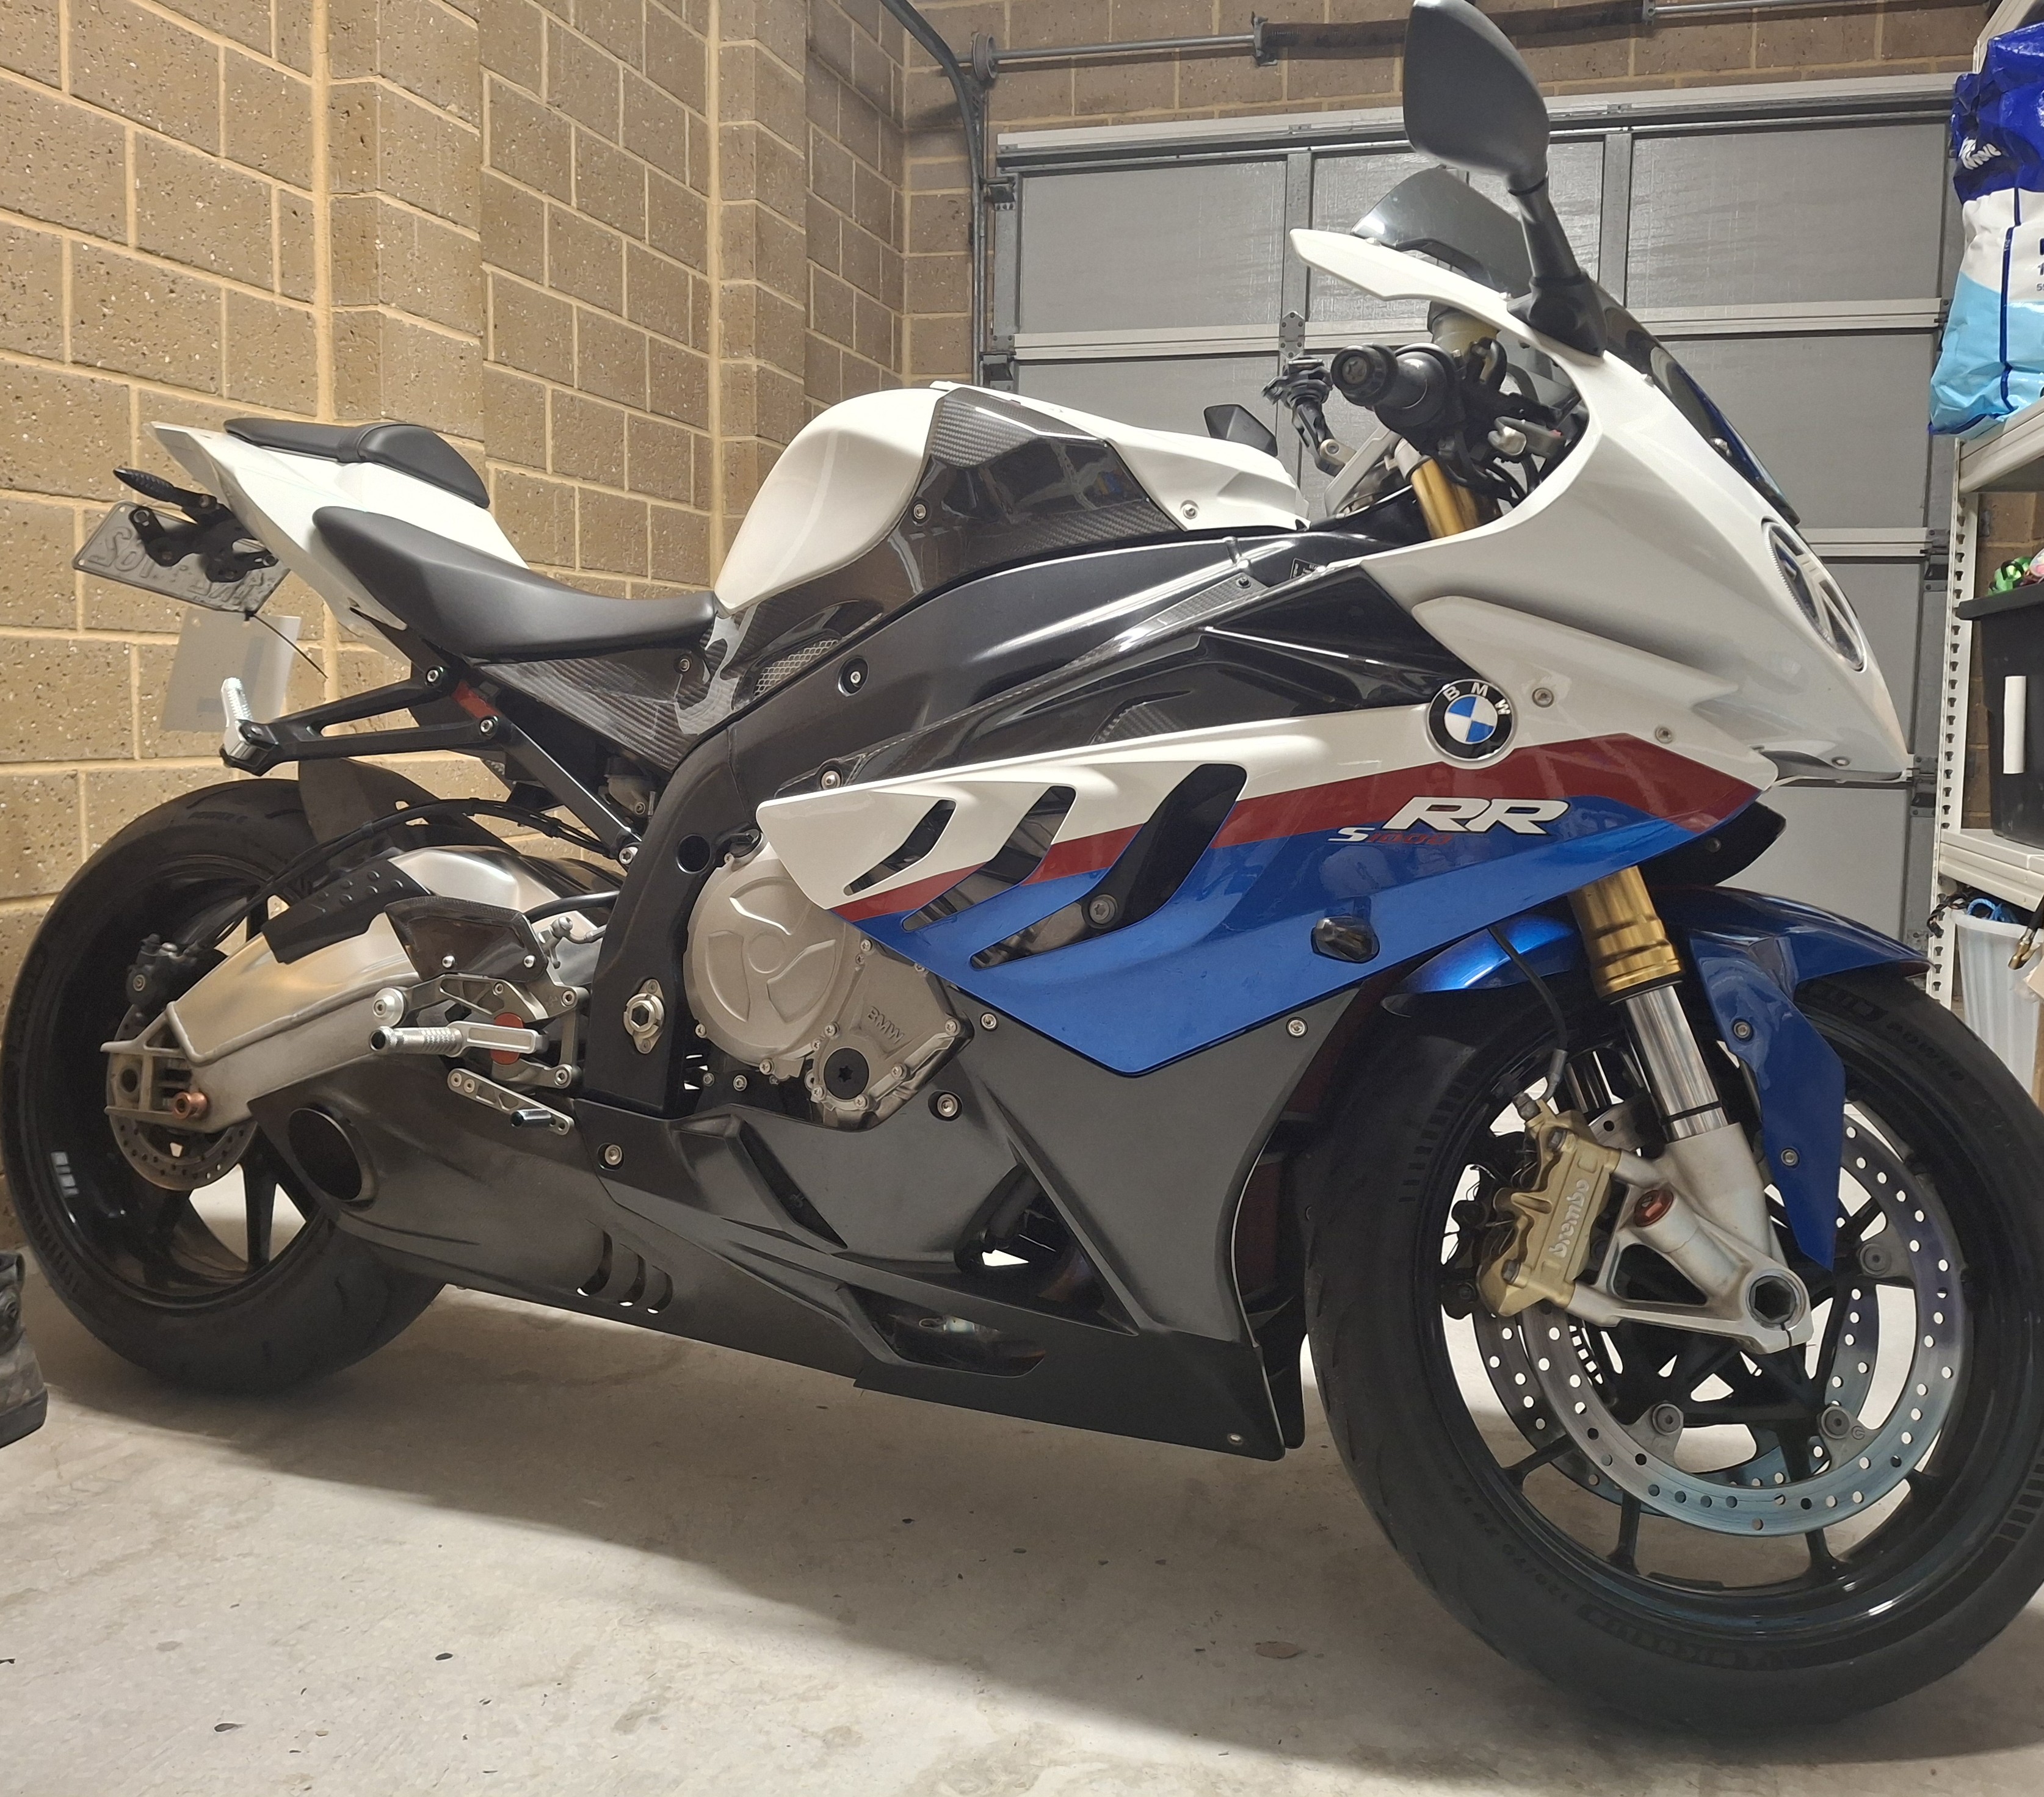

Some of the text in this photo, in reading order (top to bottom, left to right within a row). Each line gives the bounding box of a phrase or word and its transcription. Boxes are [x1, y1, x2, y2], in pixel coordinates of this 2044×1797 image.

[1443, 682, 1511, 715] BMW
[1382, 797, 1570, 834] RR
[866, 1005, 905, 1044] BMW
[1549, 1179, 1590, 1259] brembo
